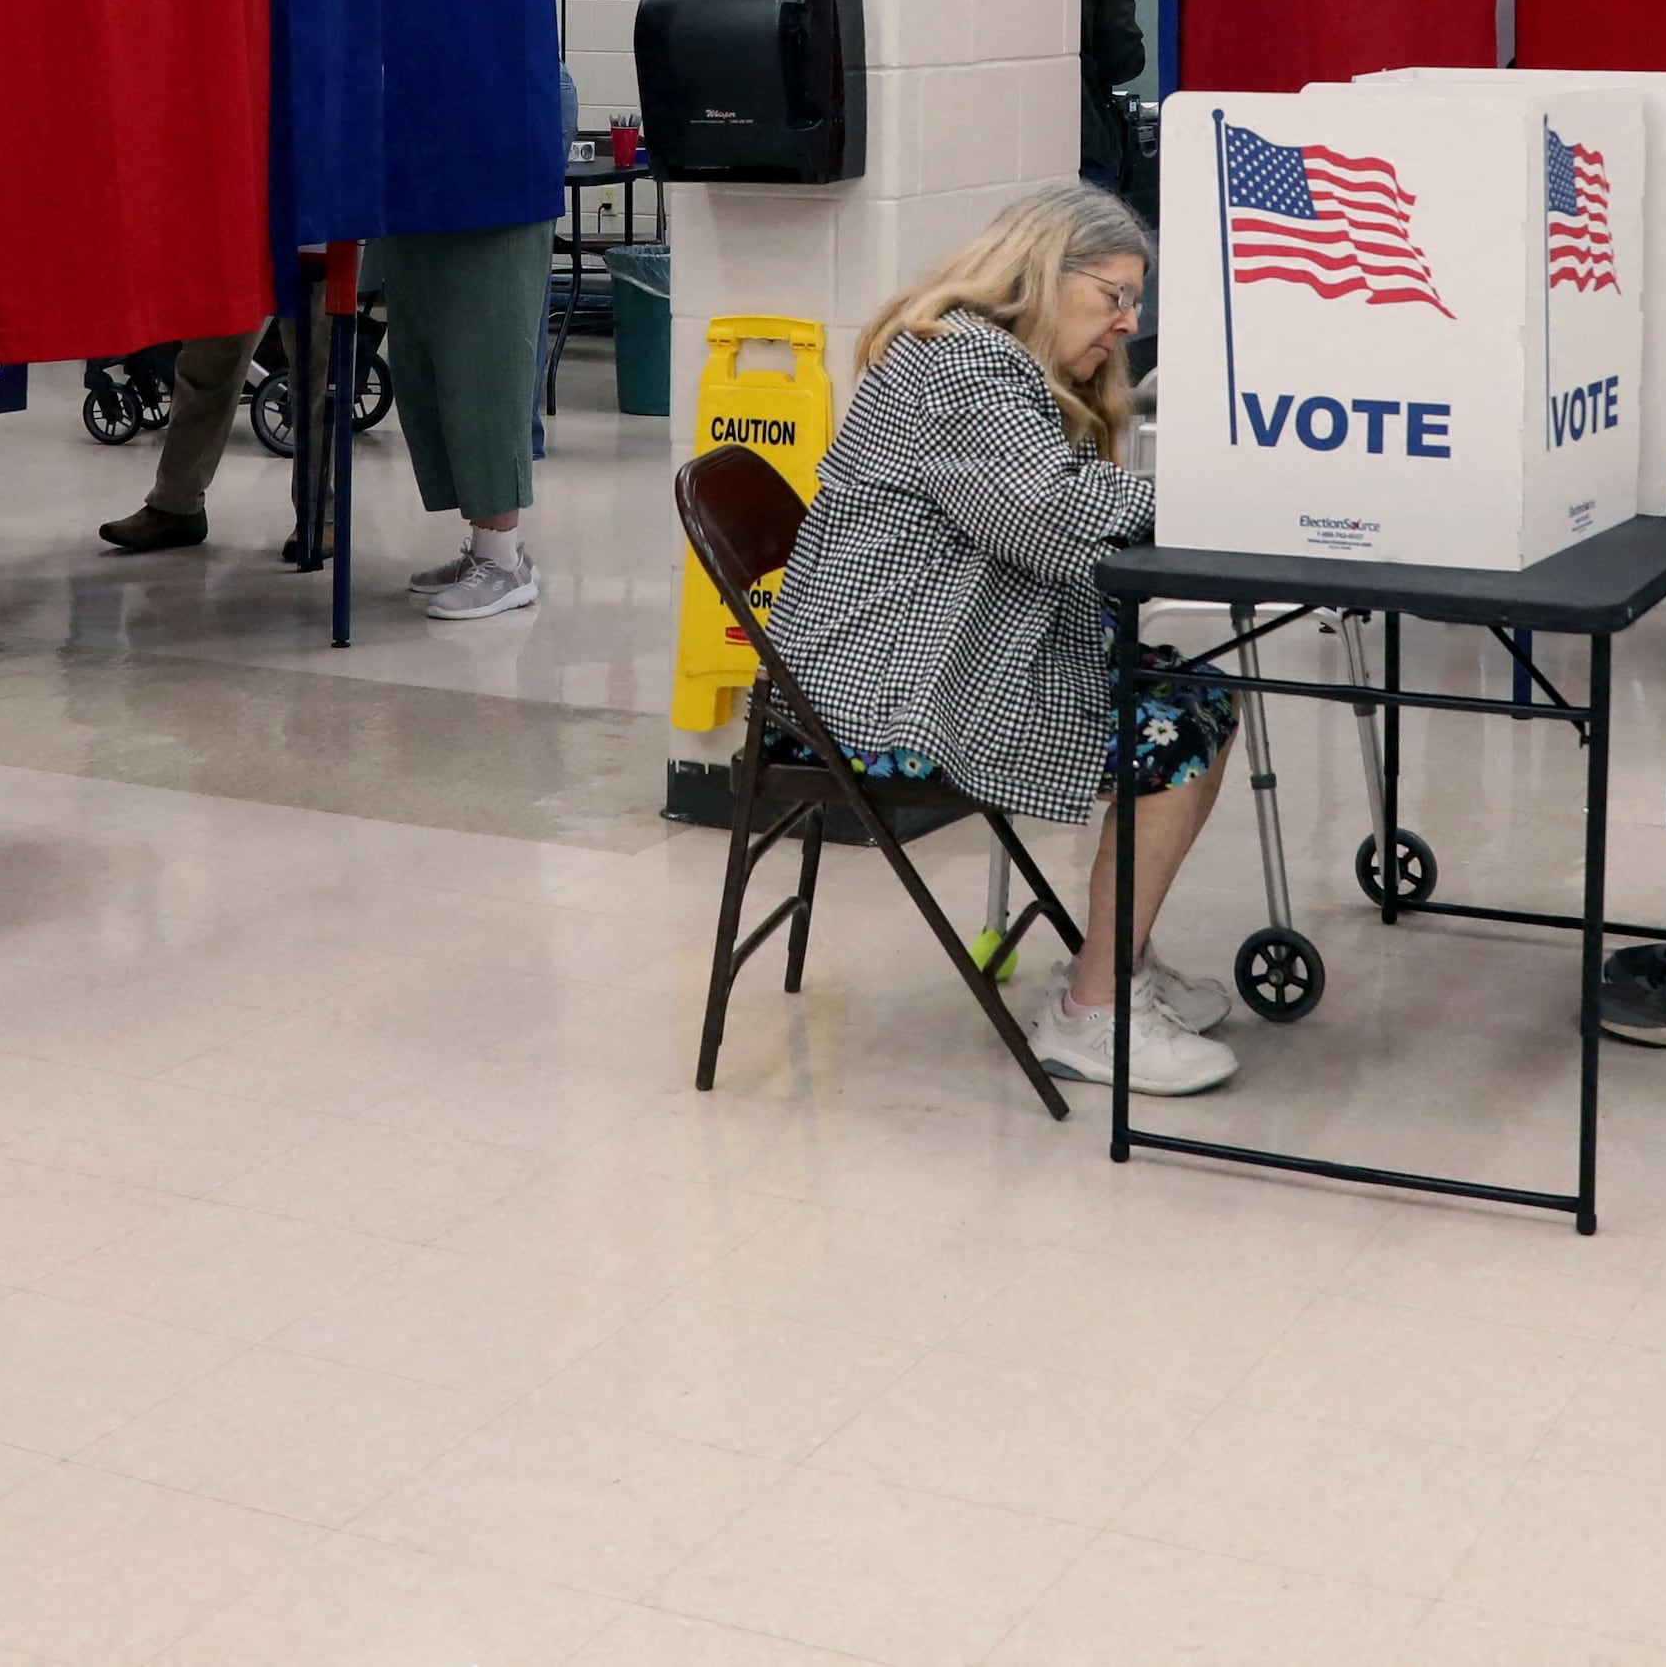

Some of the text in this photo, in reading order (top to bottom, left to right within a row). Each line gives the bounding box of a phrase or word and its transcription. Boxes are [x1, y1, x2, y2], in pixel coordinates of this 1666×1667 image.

[711, 416, 796, 446] CAUTION
[1241, 391, 1451, 458] VOTE
[1551, 375, 1619, 447] VOTE
[1299, 515, 1381, 533] ElectionSource
